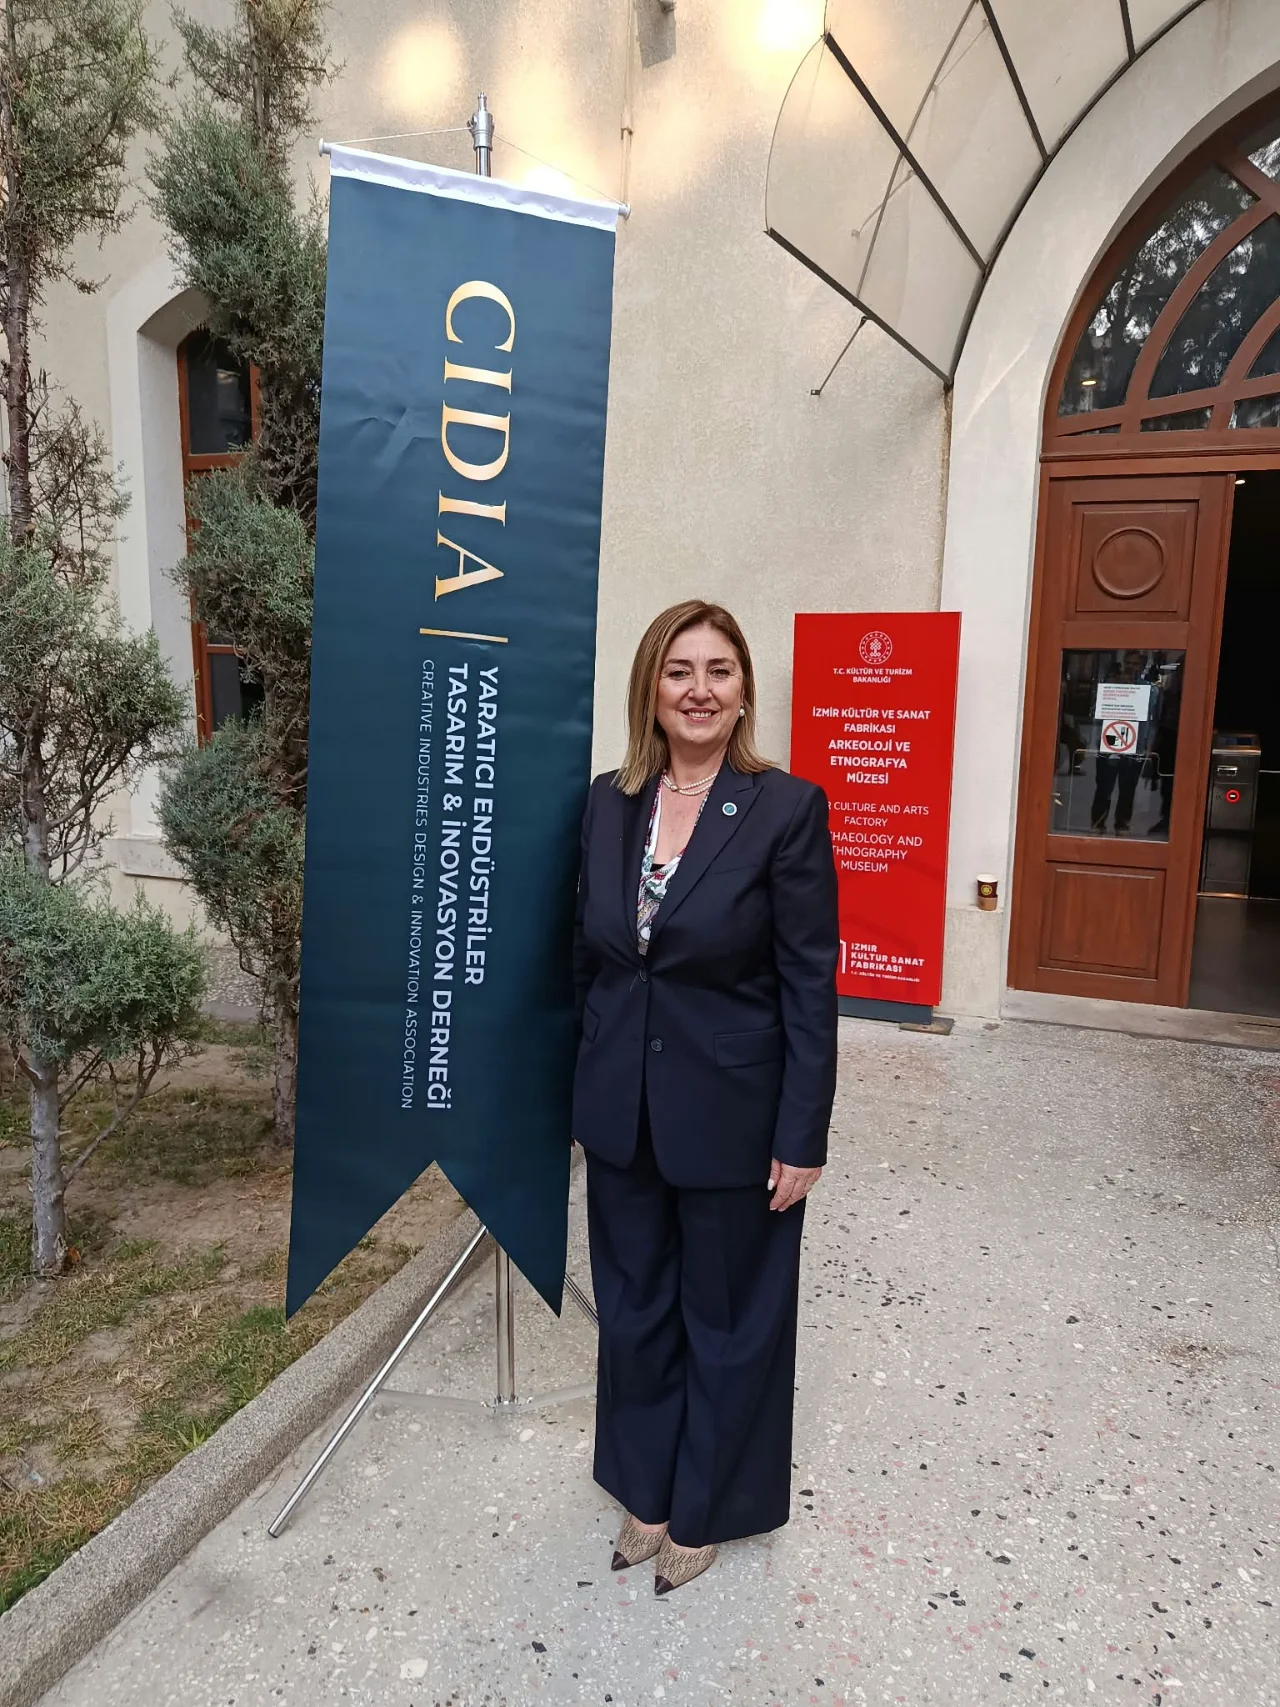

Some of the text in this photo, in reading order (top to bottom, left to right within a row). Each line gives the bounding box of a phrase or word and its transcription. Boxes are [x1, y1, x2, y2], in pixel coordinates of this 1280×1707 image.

[434, 280, 516, 602] CIDIA
[846, 667, 873, 675] KÜLTÜR
[885, 667, 912, 675] TURİZM
[812, 706, 931, 719] İZMİR KÜLTÜR VE SANAT
[844, 722, 896, 734] FABRİKASI
[828, 739, 911, 752] ARKEOLOJİ VE
[830, 755, 907, 769] ETNOGRAFYA
[846, 771, 889, 784] MÜZESİ
[833, 801, 877, 813] CULTURE
[879, 804, 901, 814] AND
[903, 805, 929, 815] ARTS
[464, 666, 499, 985] YARATICI ENDÜSTRİLER
[844, 816, 888, 827] FACTORY
[830, 831, 923, 847] HAEOLOGY AND
[832, 845, 908, 860] THNOGRAPHY
[840, 860, 888, 873] MUSEUM
[401, 659, 435, 1109] CREATIVE INDUSTRIES DESIGN & INNOVATION ASSOCIATION
[427, 662, 468, 1109] TASARIM & İNOVASYON DERNEĞİ
[891, 956, 925, 967] SANAT
